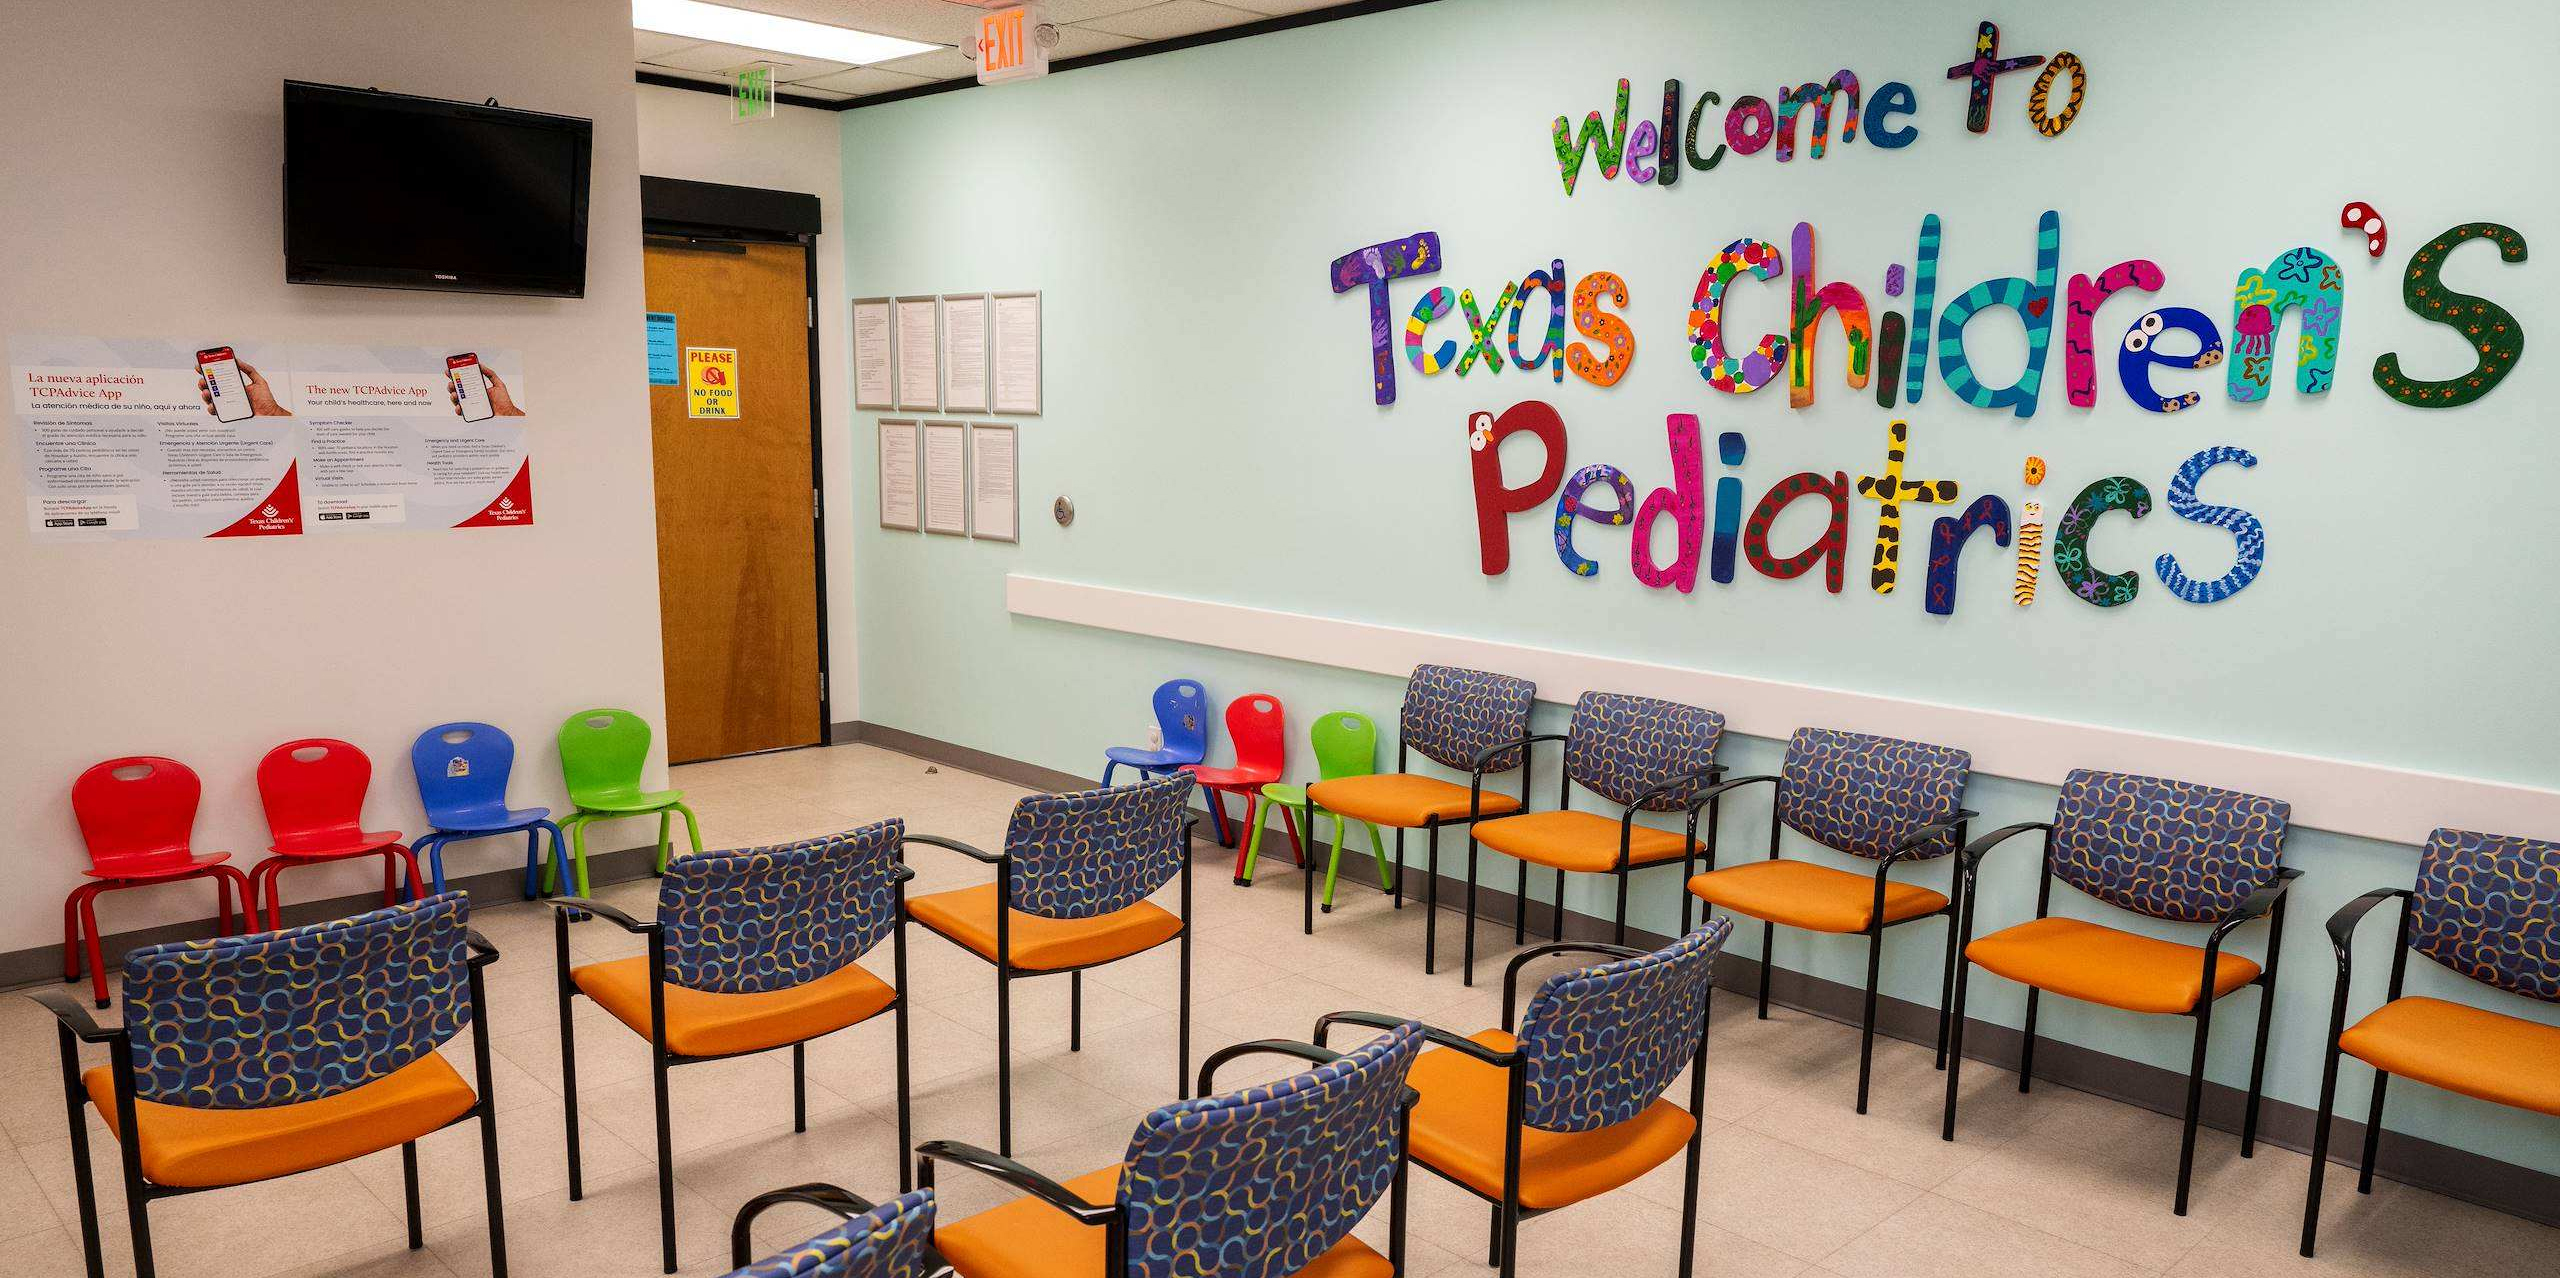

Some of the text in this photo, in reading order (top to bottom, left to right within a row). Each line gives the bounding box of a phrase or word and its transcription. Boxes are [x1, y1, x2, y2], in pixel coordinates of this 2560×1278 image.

[984, 9, 1024, 71] EXIT
[738, 68, 768, 119] EXIT
[1551, 20, 2087, 197] Welcome to
[1331, 230, 1636, 407] Texas
[691, 352, 733, 363] PLEASE
[28, 373, 145, 387] La nueva aplicación
[29, 387, 122, 401] TCPAdvice App
[306, 385, 428, 398] The new TCPAdvice App
[694, 389, 733, 397] NO FOOD
[43, 402, 78, 410] atención
[80, 402, 110, 410] médica
[111, 402, 122, 410] de
[347, 399, 386, 407] healthcare,
[706, 398, 718, 406] OR
[699, 407, 726, 415] DRINK
[1469, 400, 2265, 616] Pediatrics
